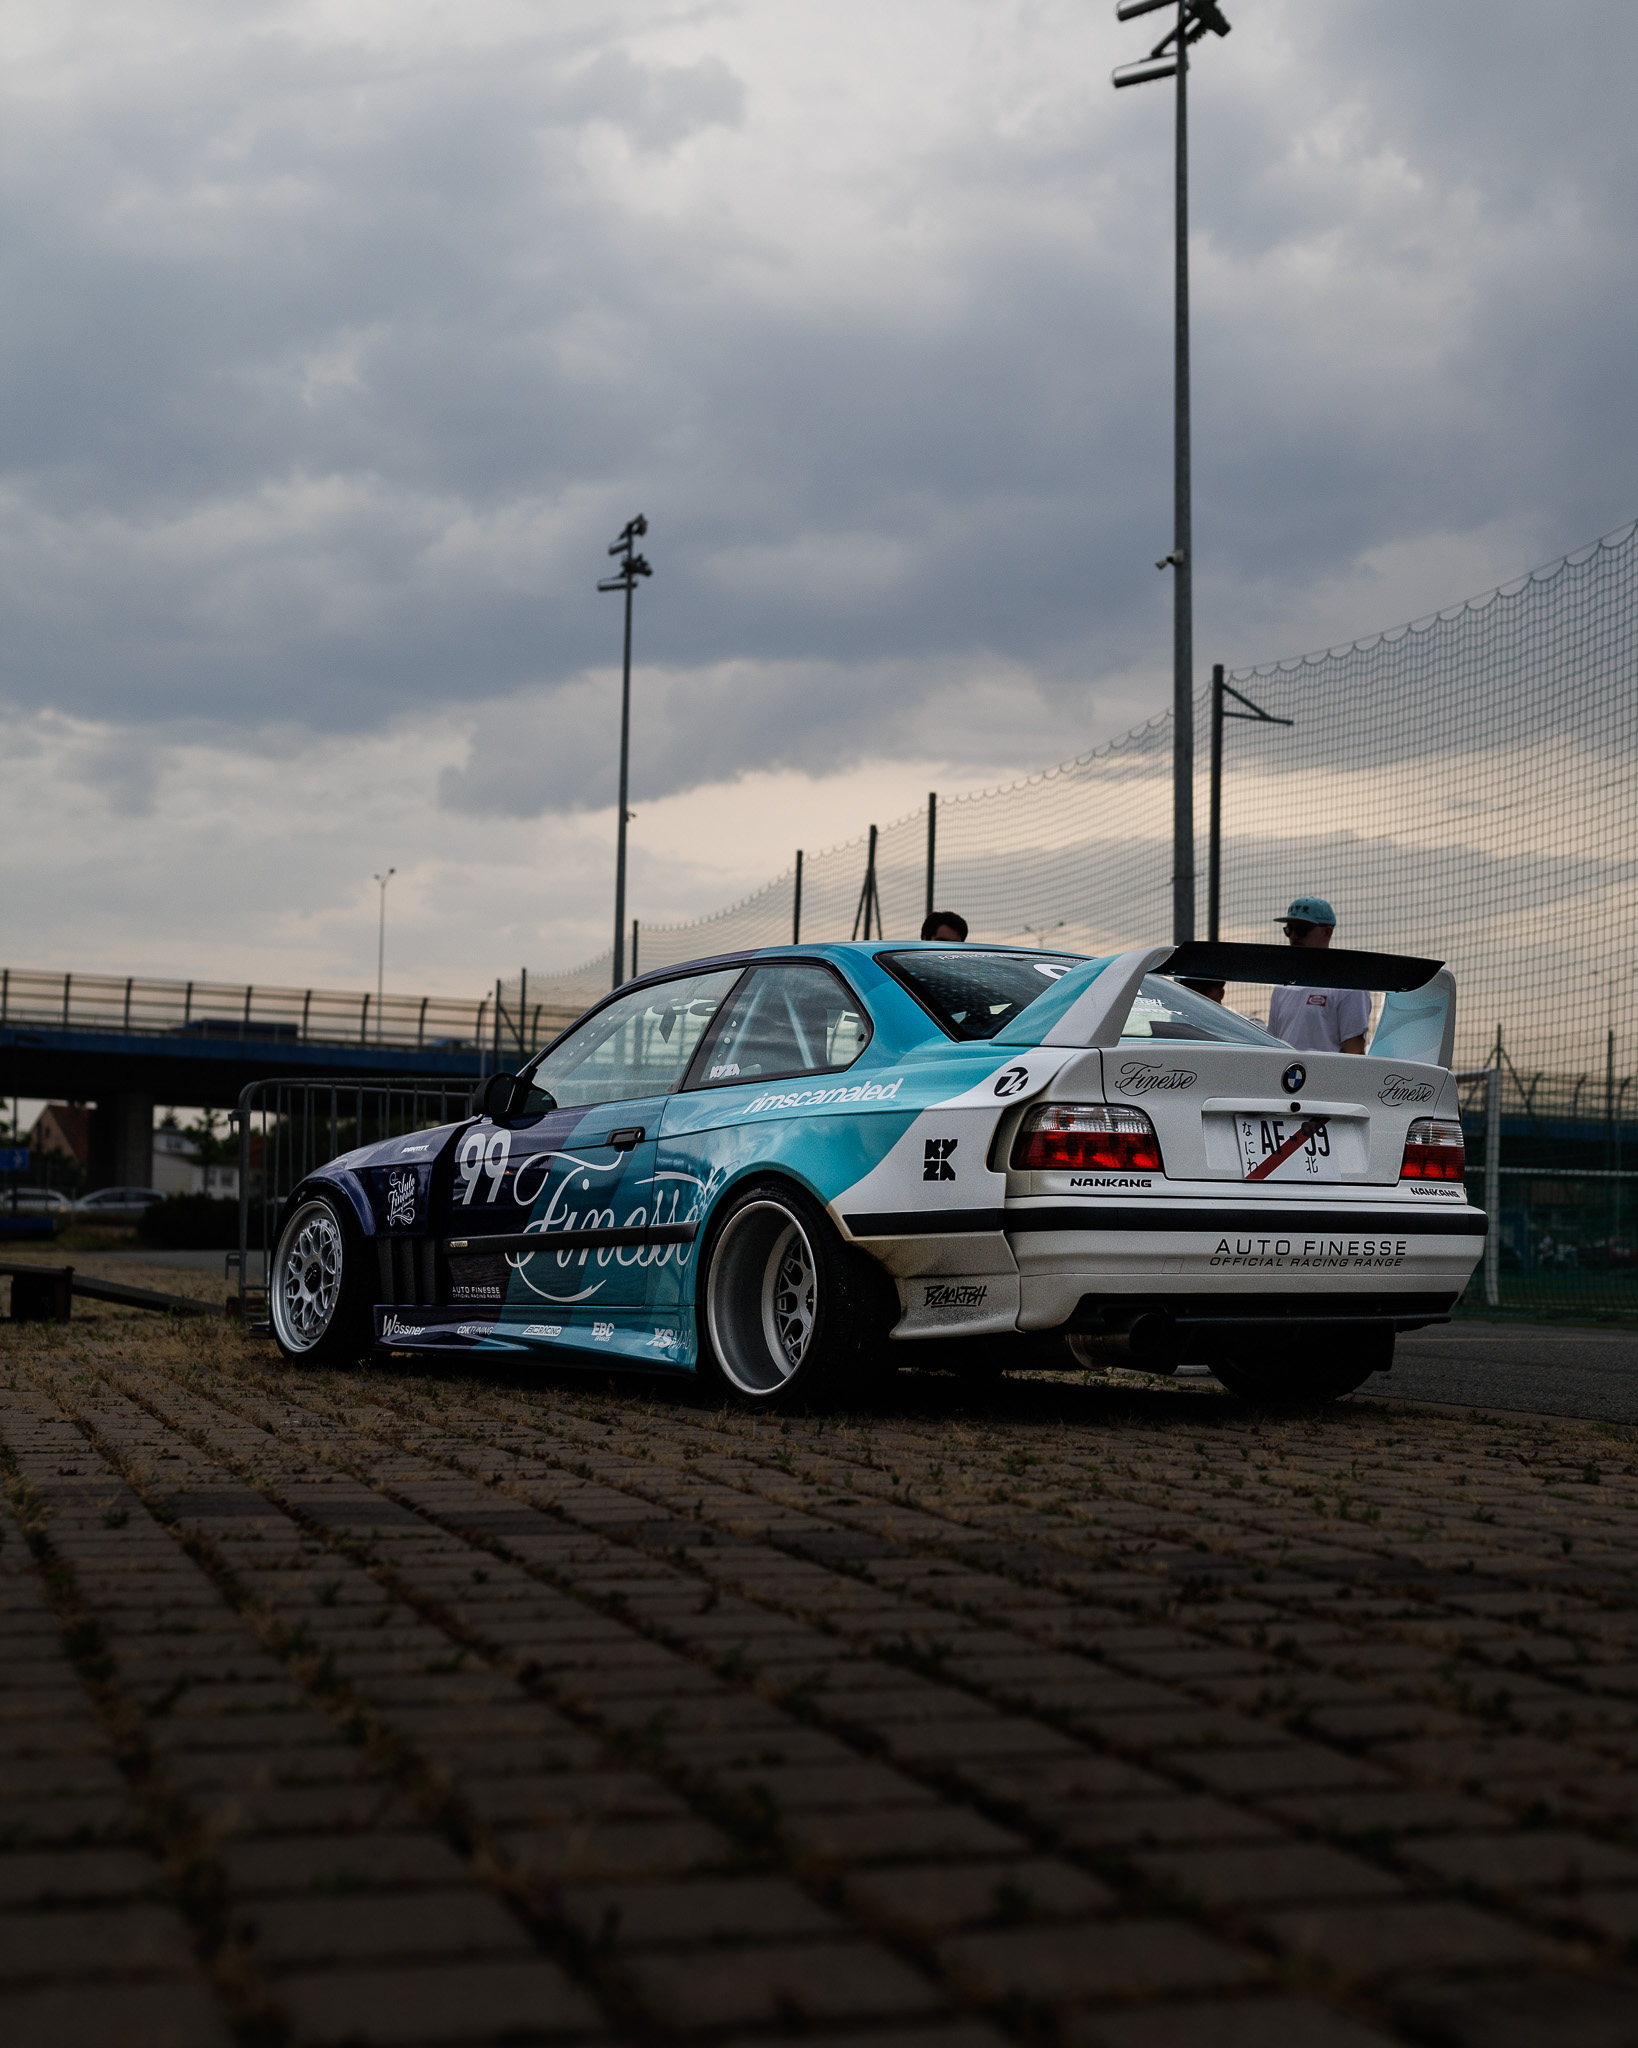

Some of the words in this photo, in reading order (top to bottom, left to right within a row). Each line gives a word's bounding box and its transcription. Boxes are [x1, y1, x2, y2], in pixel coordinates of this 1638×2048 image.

[1115, 1061, 1198, 1097] Finesse
[1378, 1073, 1436, 1107] Finesse
[459, 1129, 512, 1206] 99
[1069, 1177, 1153, 1188] NANKANG
[1410, 1186, 1461, 1199] NANKANG
[1214, 1238, 1291, 1255] AUTO
[1302, 1240, 1407, 1256] FINESSE
[1209, 1256, 1284, 1267] OFFICIAL
[1289, 1257, 1349, 1267] RACING
[1352, 1258, 1404, 1267] RANGE
[452, 1286, 470, 1294] AUTO
[471, 1286, 500, 1294] FINESSE
[382, 1313, 426, 1337] Wössner
[590, 1321, 615, 1337] EBC
